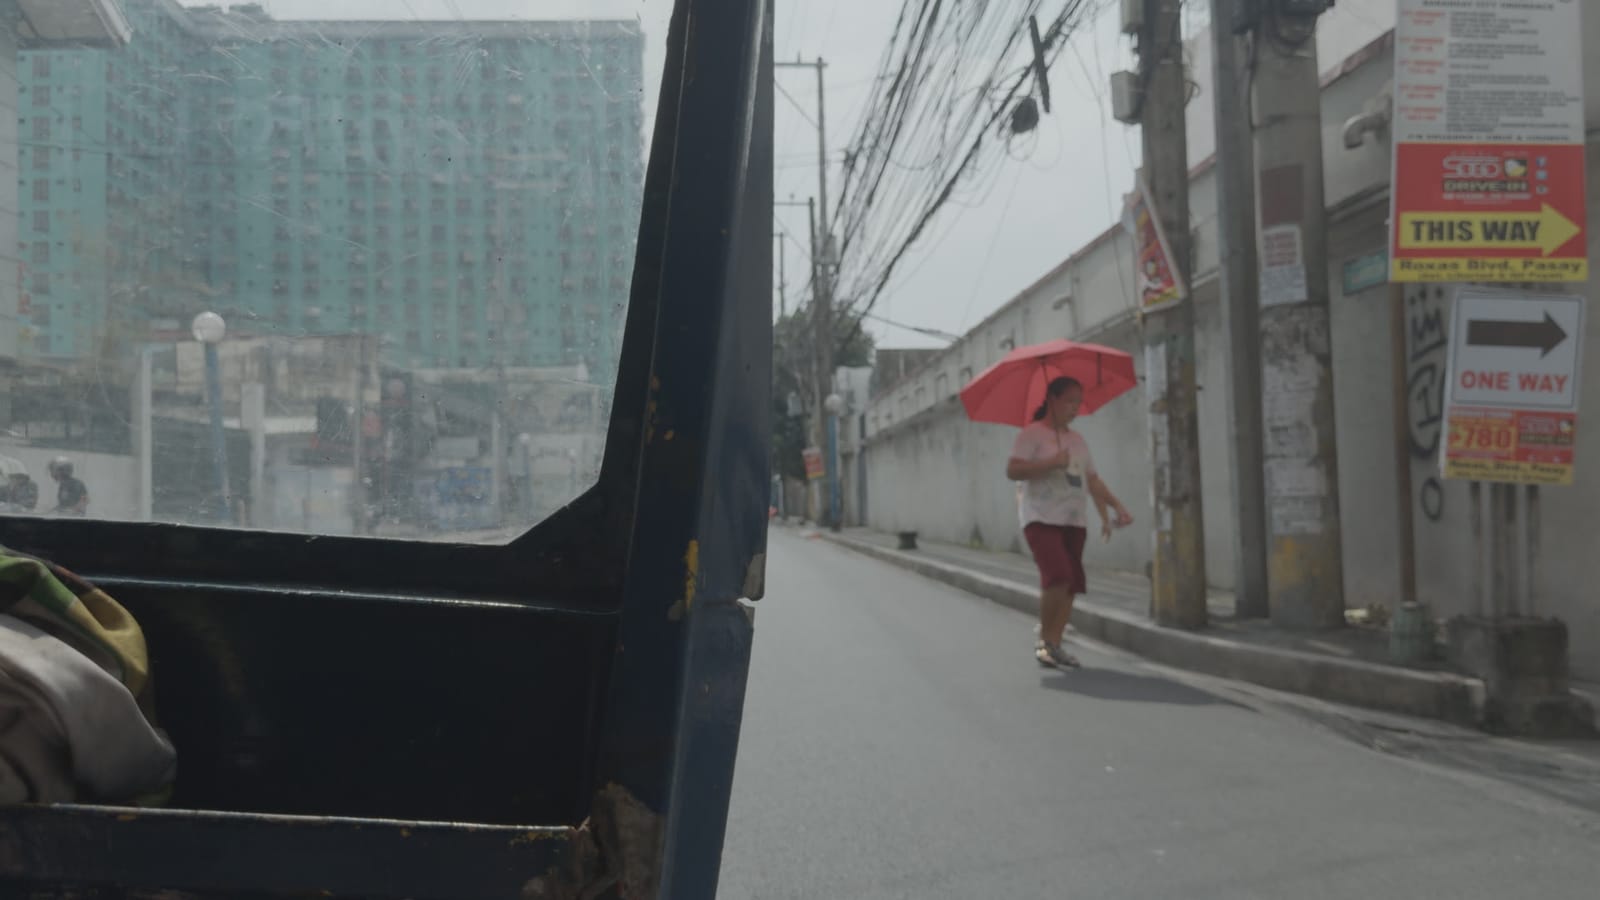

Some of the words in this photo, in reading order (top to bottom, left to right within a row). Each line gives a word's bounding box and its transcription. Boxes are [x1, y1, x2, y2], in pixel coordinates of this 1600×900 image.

[1411, 220, 1473, 241] THIS
[1481, 220, 1541, 242] WAY
[1460, 370, 1510, 391] ONE
[1519, 372, 1568, 393] WAY
